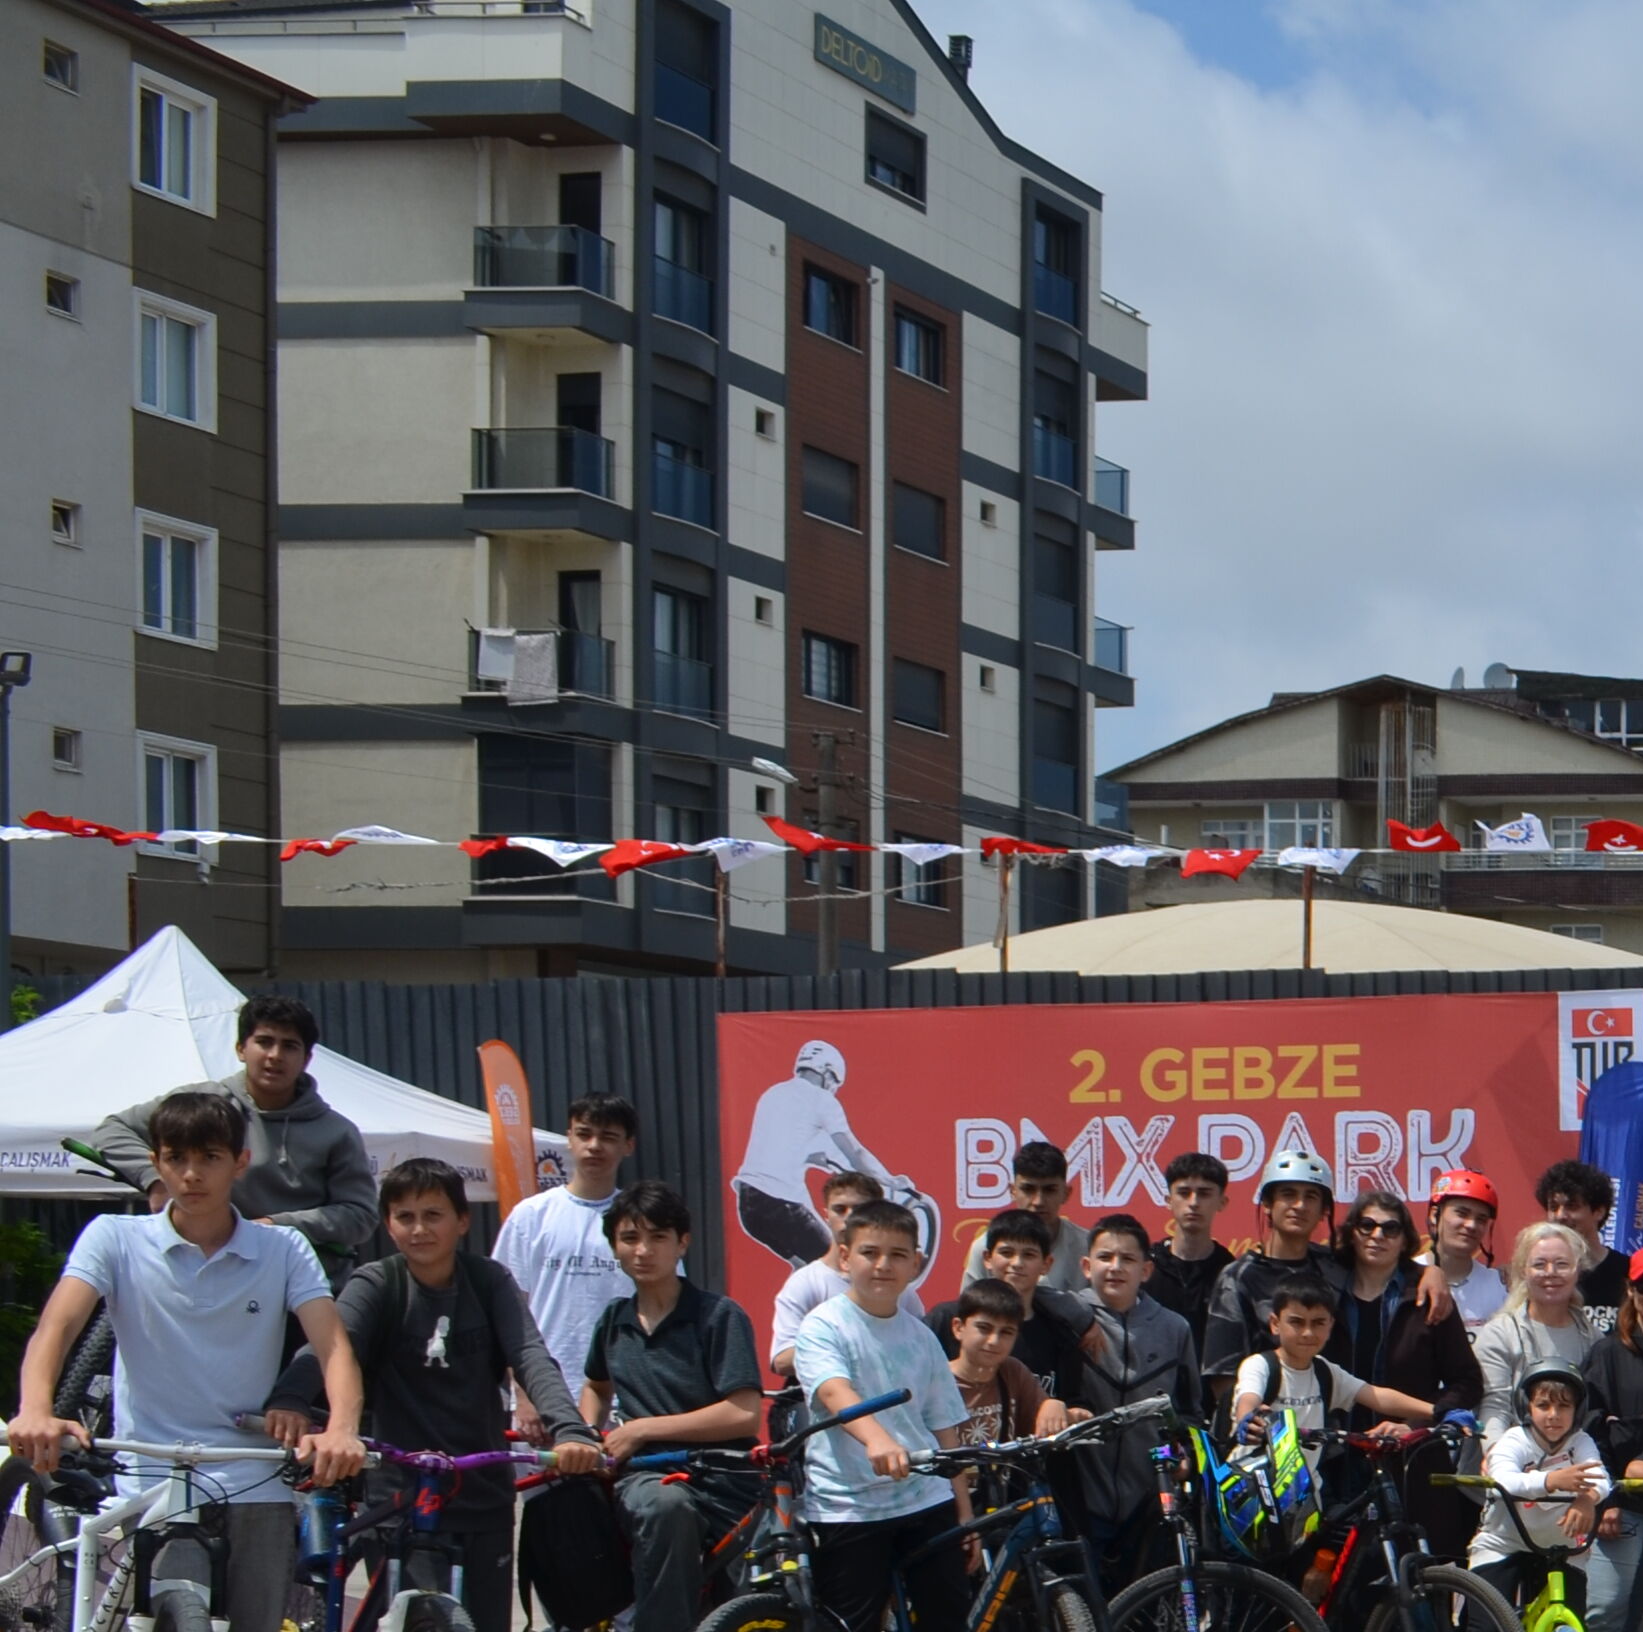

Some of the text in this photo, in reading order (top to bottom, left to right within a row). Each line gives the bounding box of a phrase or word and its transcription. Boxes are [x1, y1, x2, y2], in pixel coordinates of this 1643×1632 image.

[1069, 1044, 1361, 1103] 2. GEBZE
[955, 1109, 1475, 1208] BMX PARK
